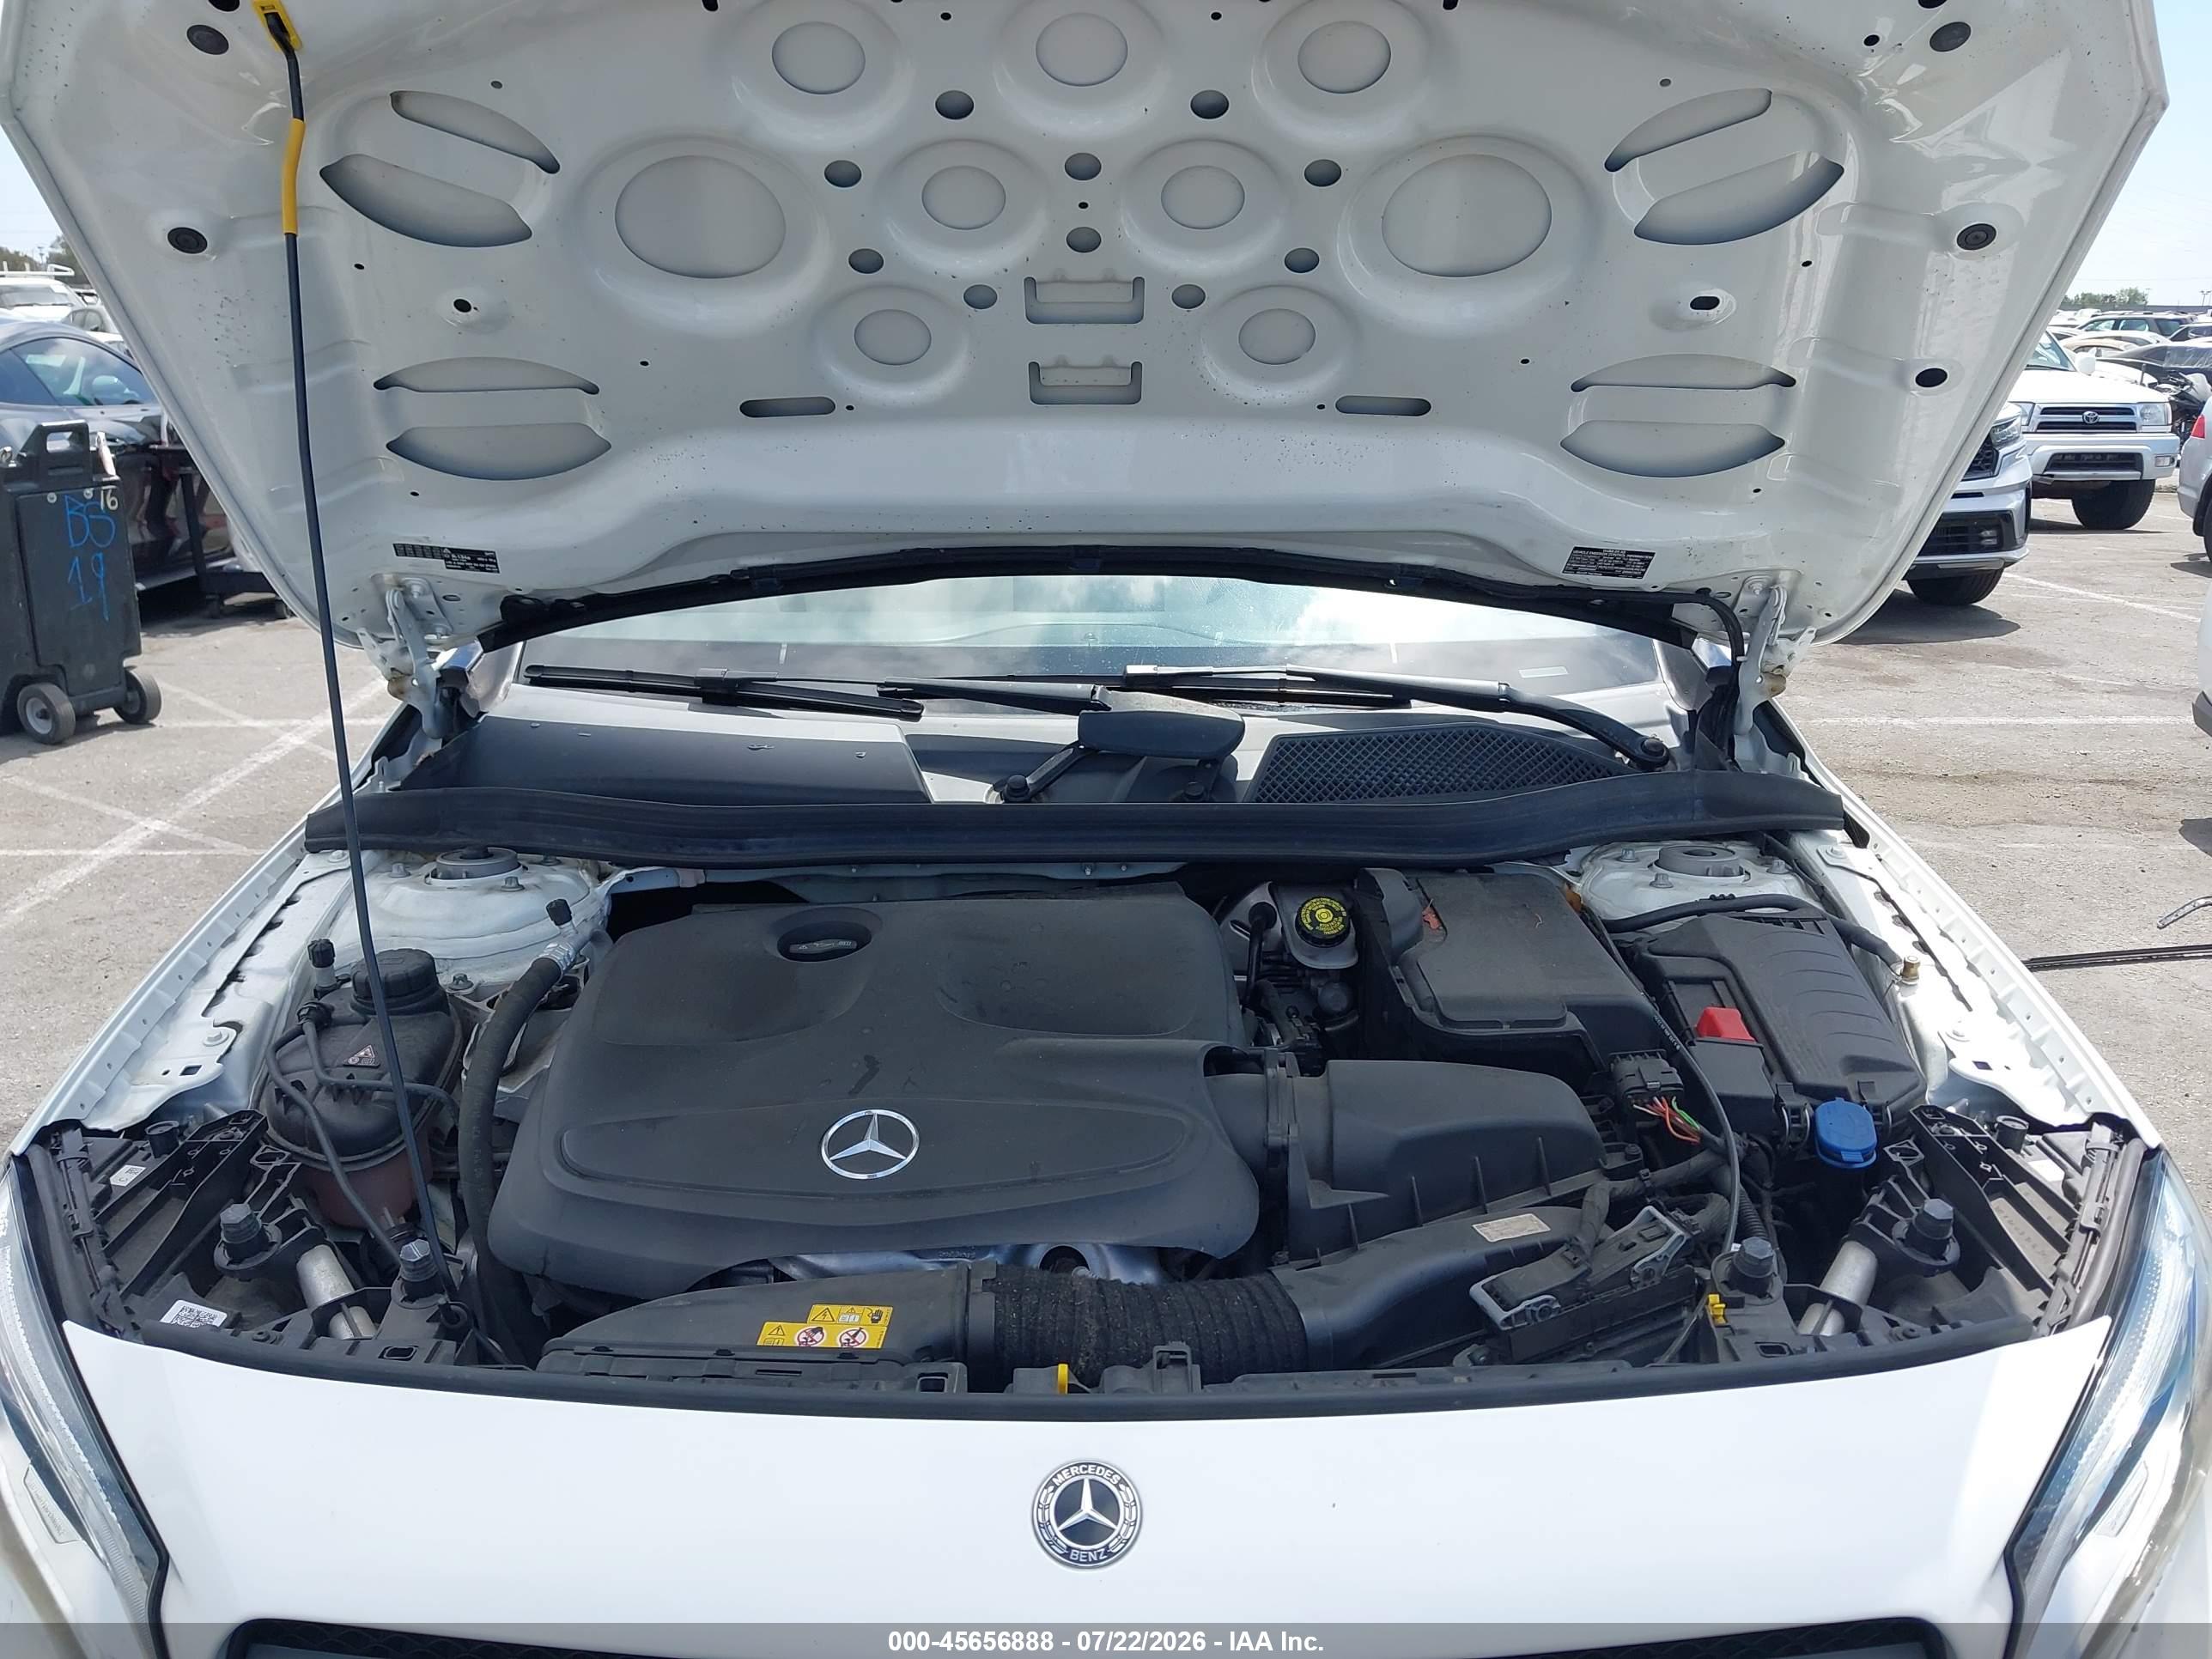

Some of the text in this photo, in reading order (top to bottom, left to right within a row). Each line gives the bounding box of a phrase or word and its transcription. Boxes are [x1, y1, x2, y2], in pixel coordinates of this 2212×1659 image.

[68, 551, 110, 622] 19
[1052, 1464, 1121, 1486] MERCEDES
[1069, 1548, 1109, 1562] BENZ
